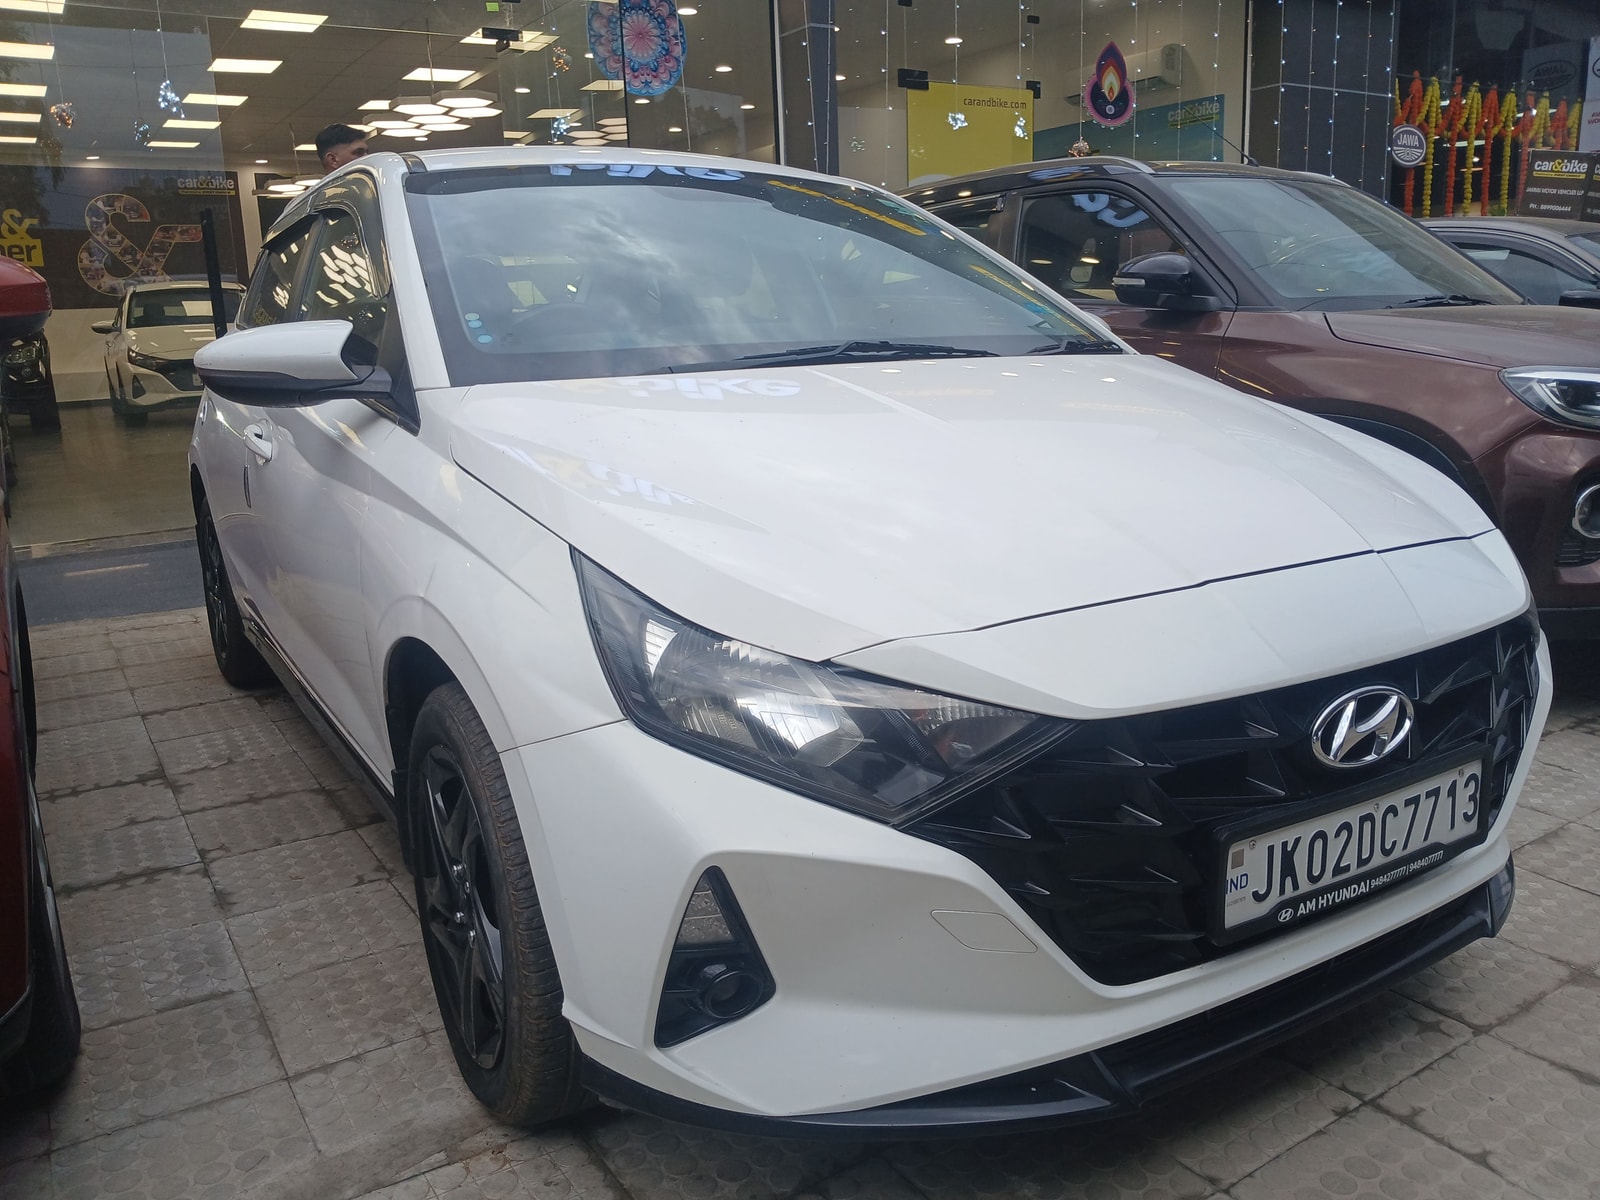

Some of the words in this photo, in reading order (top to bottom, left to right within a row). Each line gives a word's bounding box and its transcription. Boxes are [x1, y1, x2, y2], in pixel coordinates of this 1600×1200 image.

[963, 97, 1027, 109] carandbike.com
[1397, 133, 1419, 147] JAWA
[1535, 159, 1588, 172] car&bike
[177, 175, 235, 189] car&bike
[1251, 772, 1480, 903] JK02DC7713
[1225, 872, 1249, 895] IND
[1297, 898, 1316, 917] AM
[1318, 879, 1369, 909] HYUNDAI
